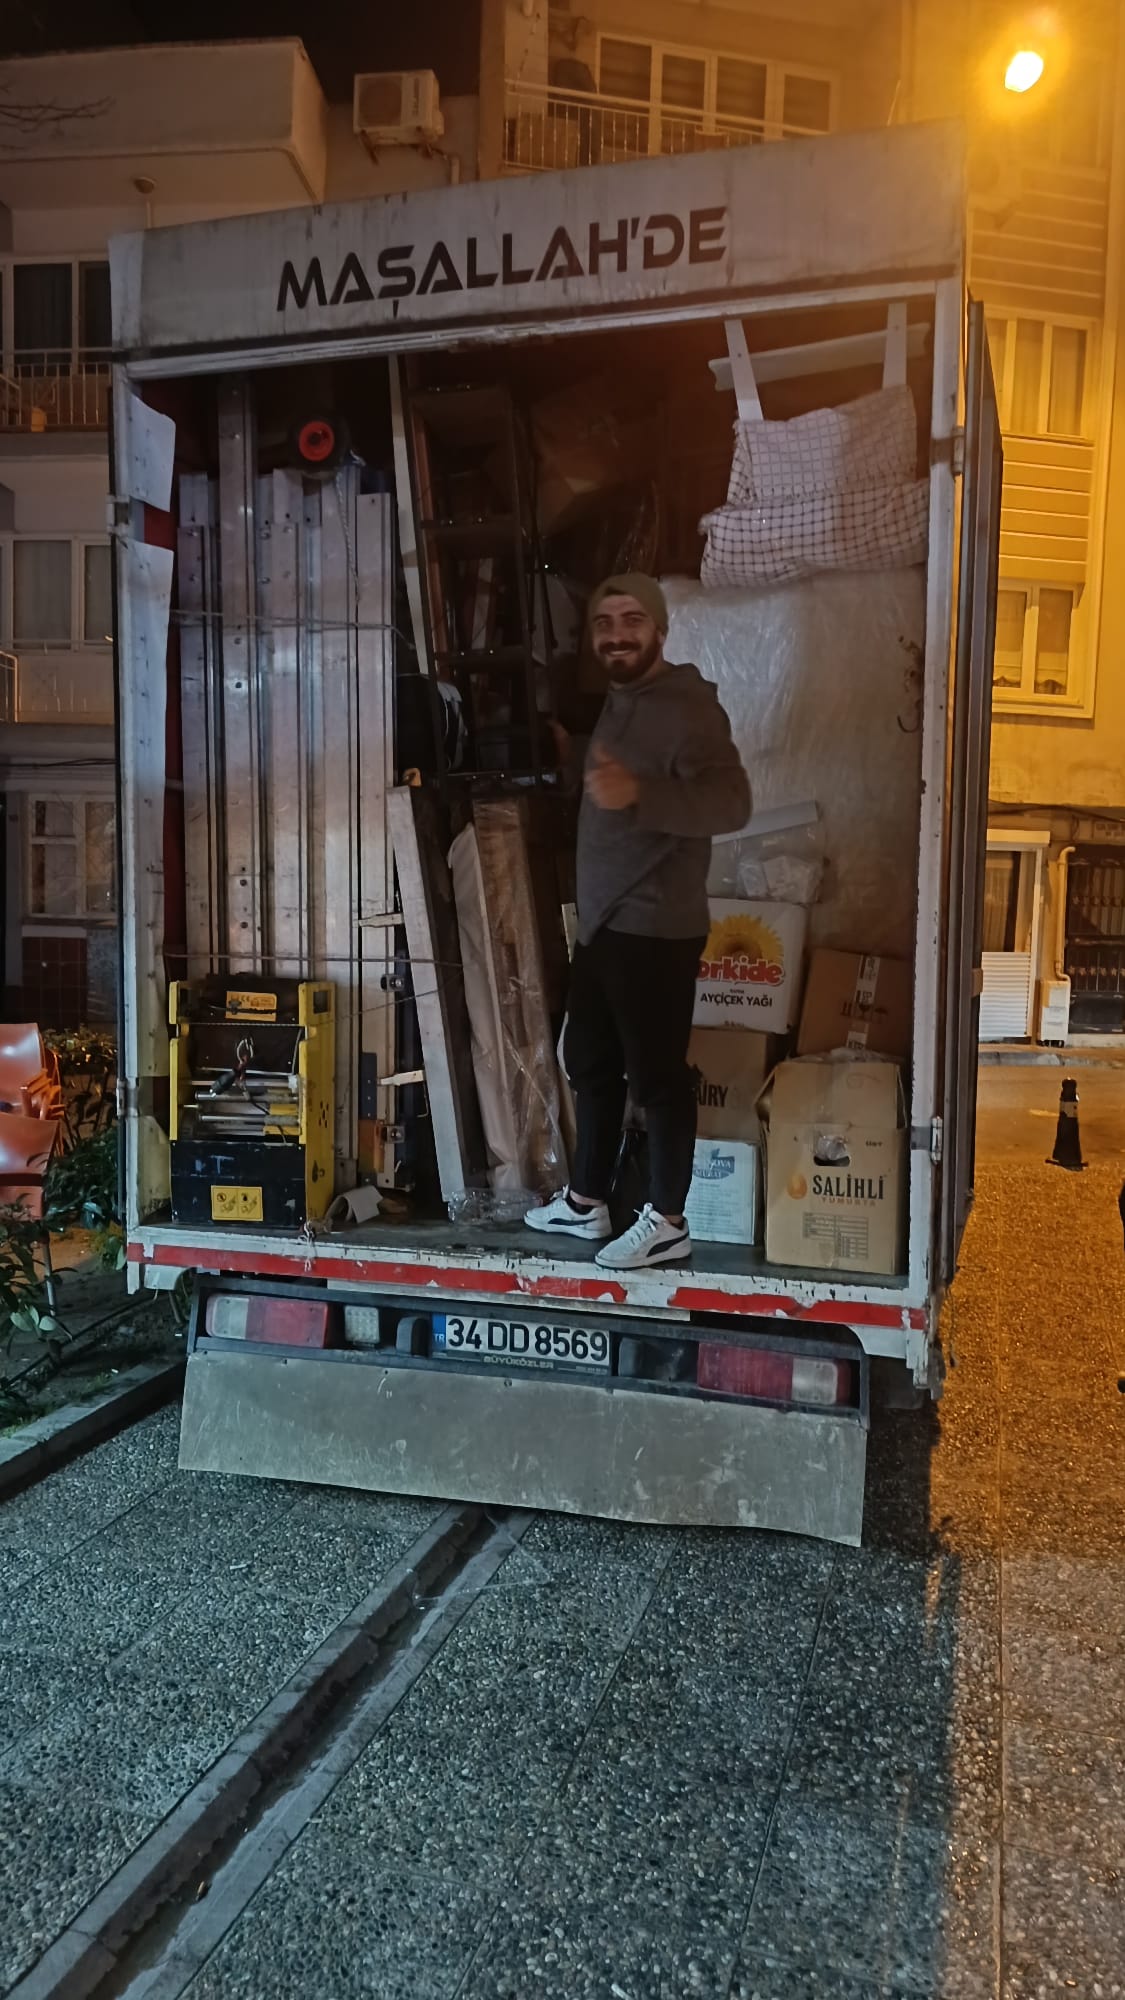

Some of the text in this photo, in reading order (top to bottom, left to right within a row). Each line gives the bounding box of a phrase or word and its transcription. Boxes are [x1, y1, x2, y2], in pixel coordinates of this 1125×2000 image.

[276, 206, 728, 319] MAŞALLAH'DE
[700, 992, 773, 1007] AYÇİÇEK YAĞI
[812, 1174, 884, 1200] SALİHLİ
[434, 1333, 445, 1343] TR
[448, 1318, 608, 1362] 34 DD 8569
